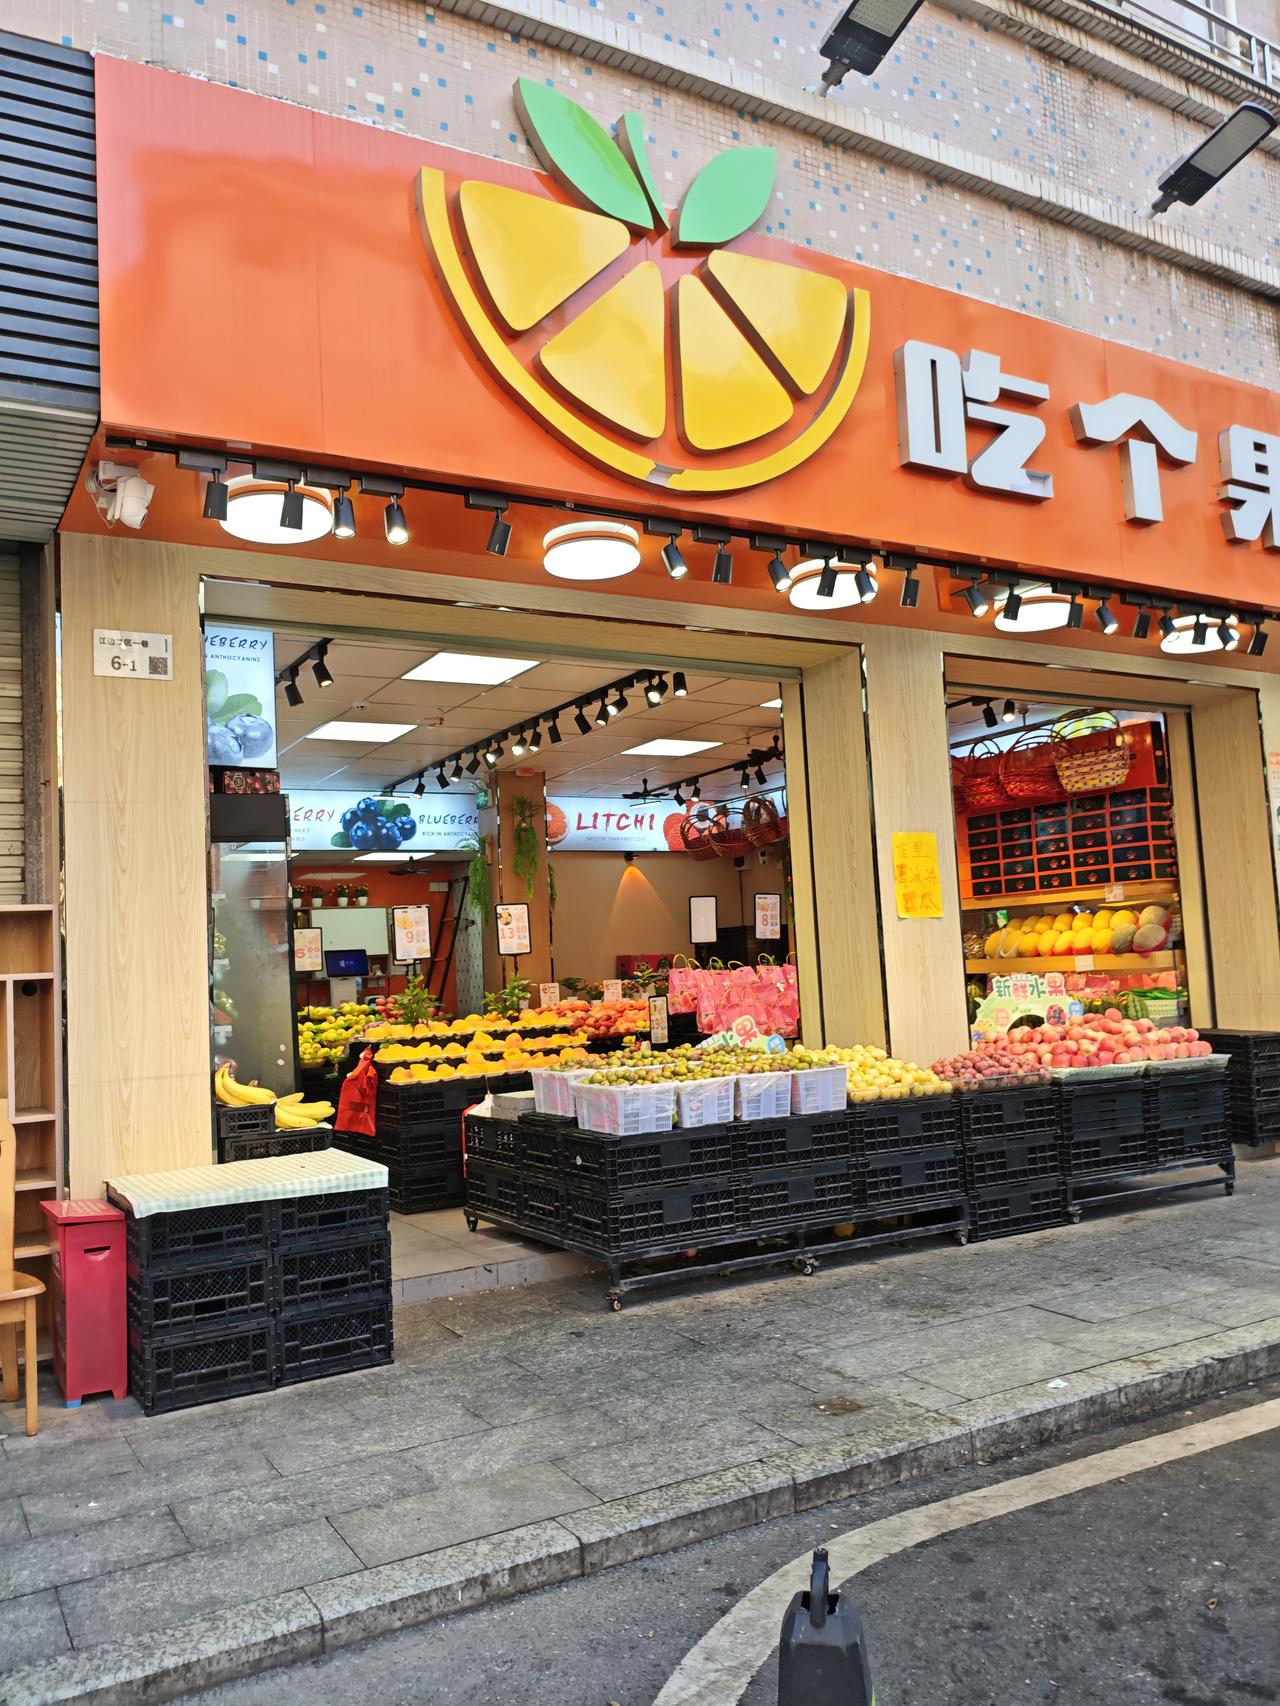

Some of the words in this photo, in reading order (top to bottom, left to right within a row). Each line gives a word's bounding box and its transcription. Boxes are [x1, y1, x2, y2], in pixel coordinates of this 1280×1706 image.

[205, 634, 268, 650] EBERRY
[111, 655, 138, 672] 6-1
[575, 812, 656, 833] LITCHI
[762, 913, 769, 926] 8
[405, 930, 414, 943] 9
[499, 927, 515, 940] 13
[994, 974, 1065, 999] 新鲜水果
